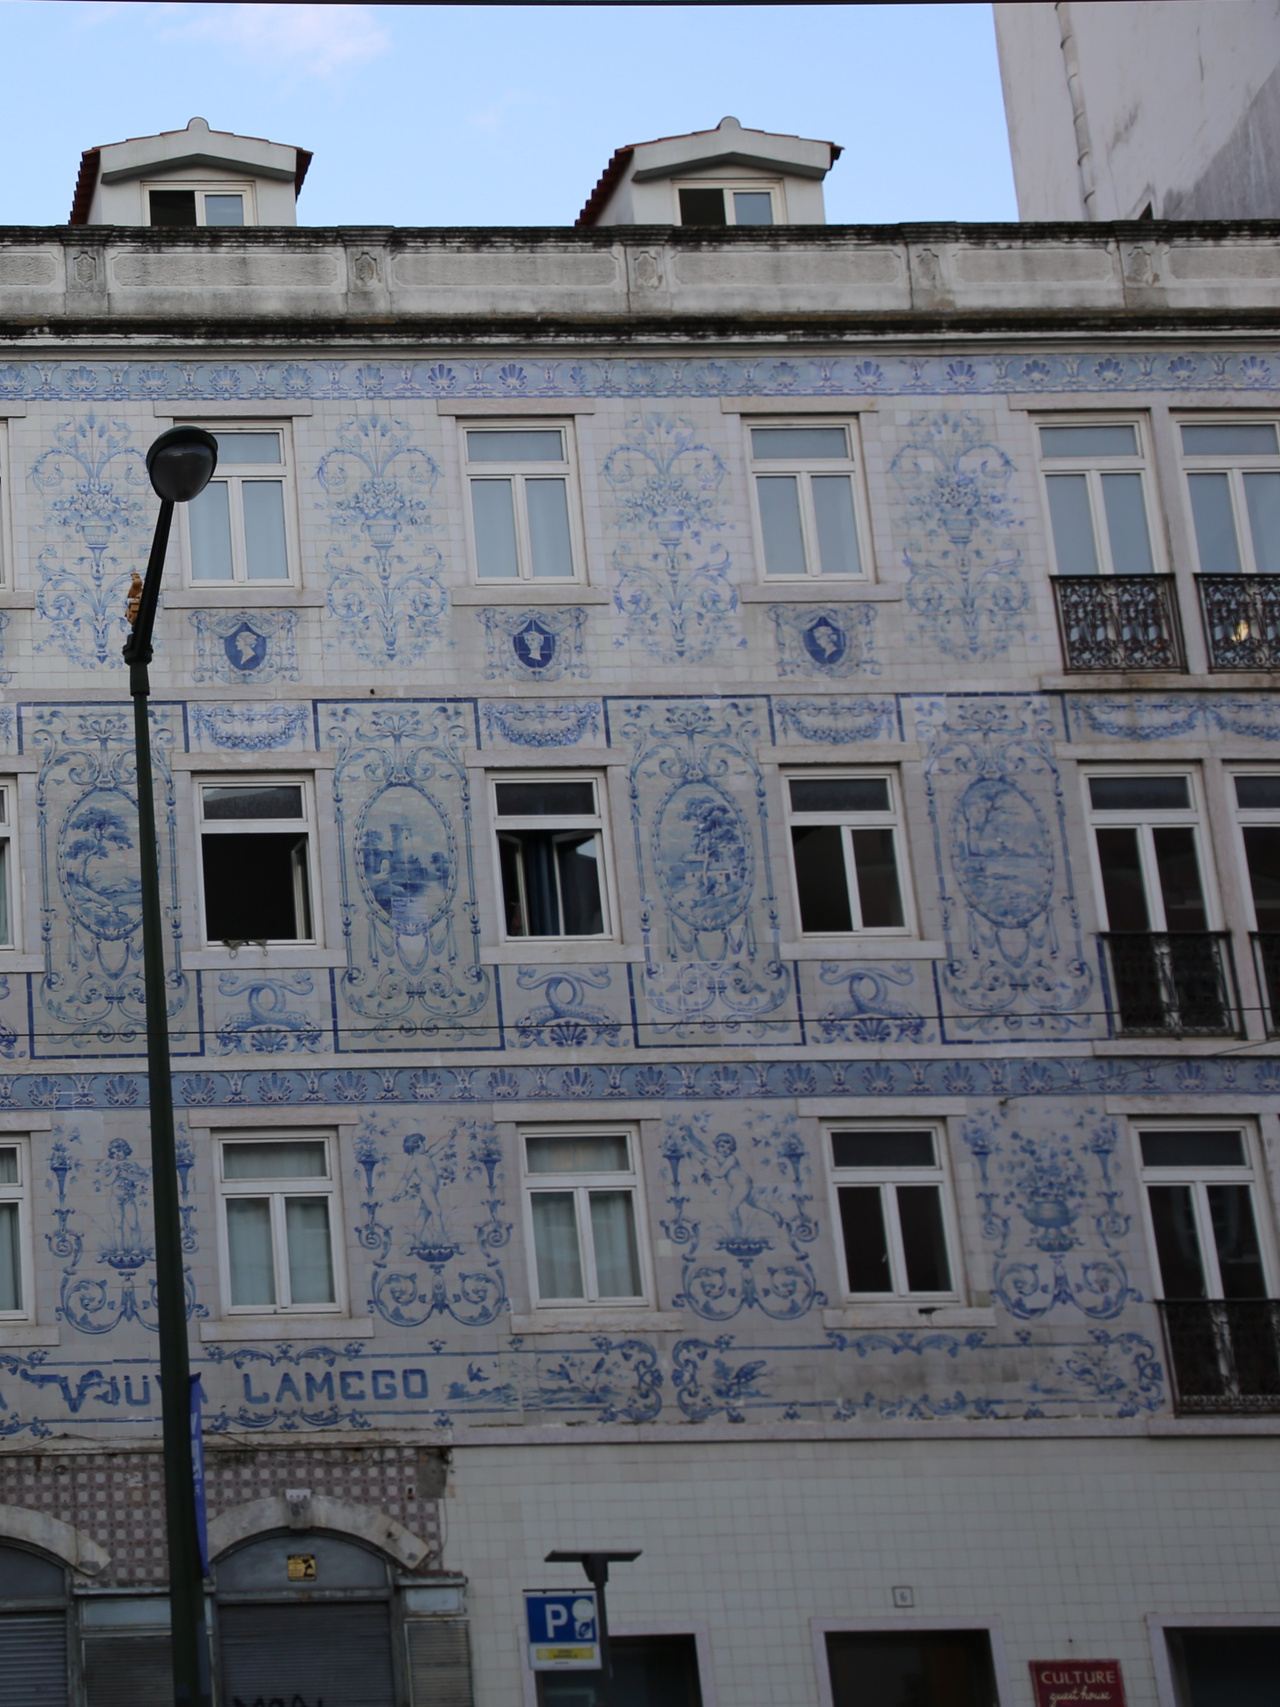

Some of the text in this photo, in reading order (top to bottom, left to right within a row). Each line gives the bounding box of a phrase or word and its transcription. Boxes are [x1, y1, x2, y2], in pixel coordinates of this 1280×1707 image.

[243, 1368, 428, 1404] LAMEGO
[544, 1603, 569, 1639] P
[1040, 1670, 1115, 1684] CULTURE
[1049, 1686, 1112, 1707] guest house
